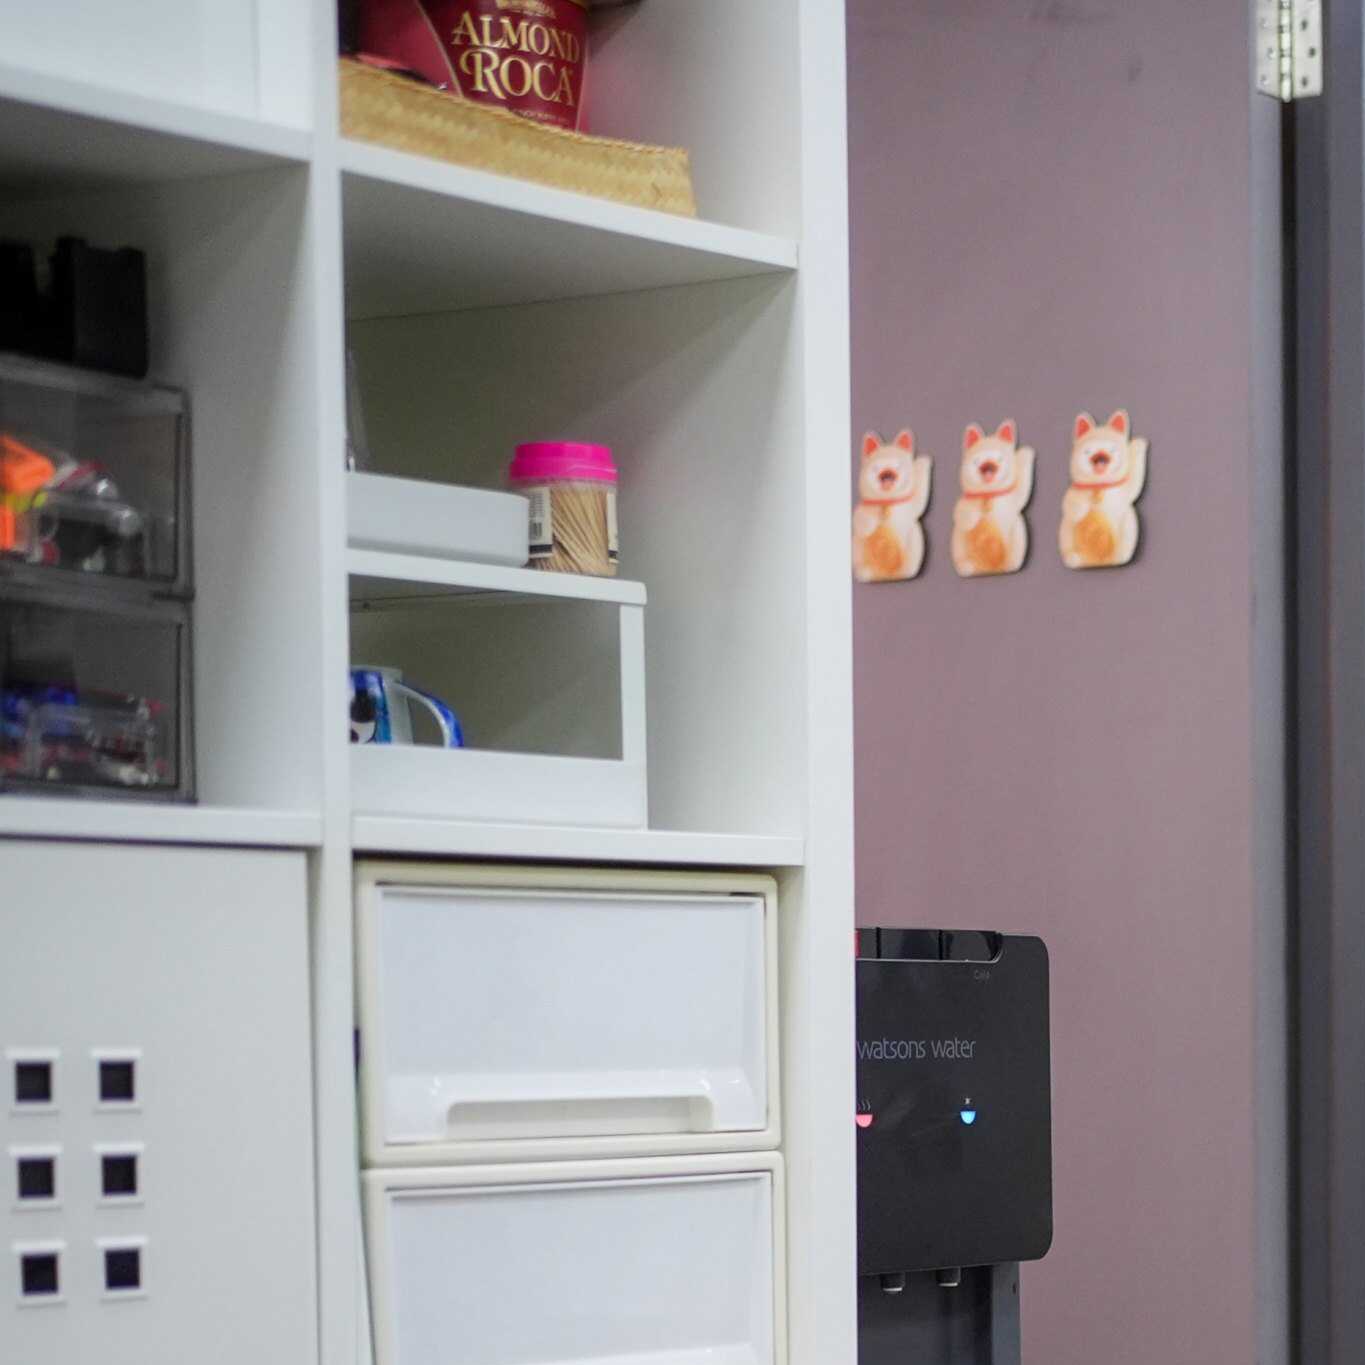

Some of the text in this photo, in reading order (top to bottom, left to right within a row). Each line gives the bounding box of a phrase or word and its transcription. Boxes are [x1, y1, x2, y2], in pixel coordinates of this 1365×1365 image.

[451, 11, 580, 63] ALMOND
[460, 48, 577, 107] ROCA
[856, 1037, 976, 1059] watsons water
